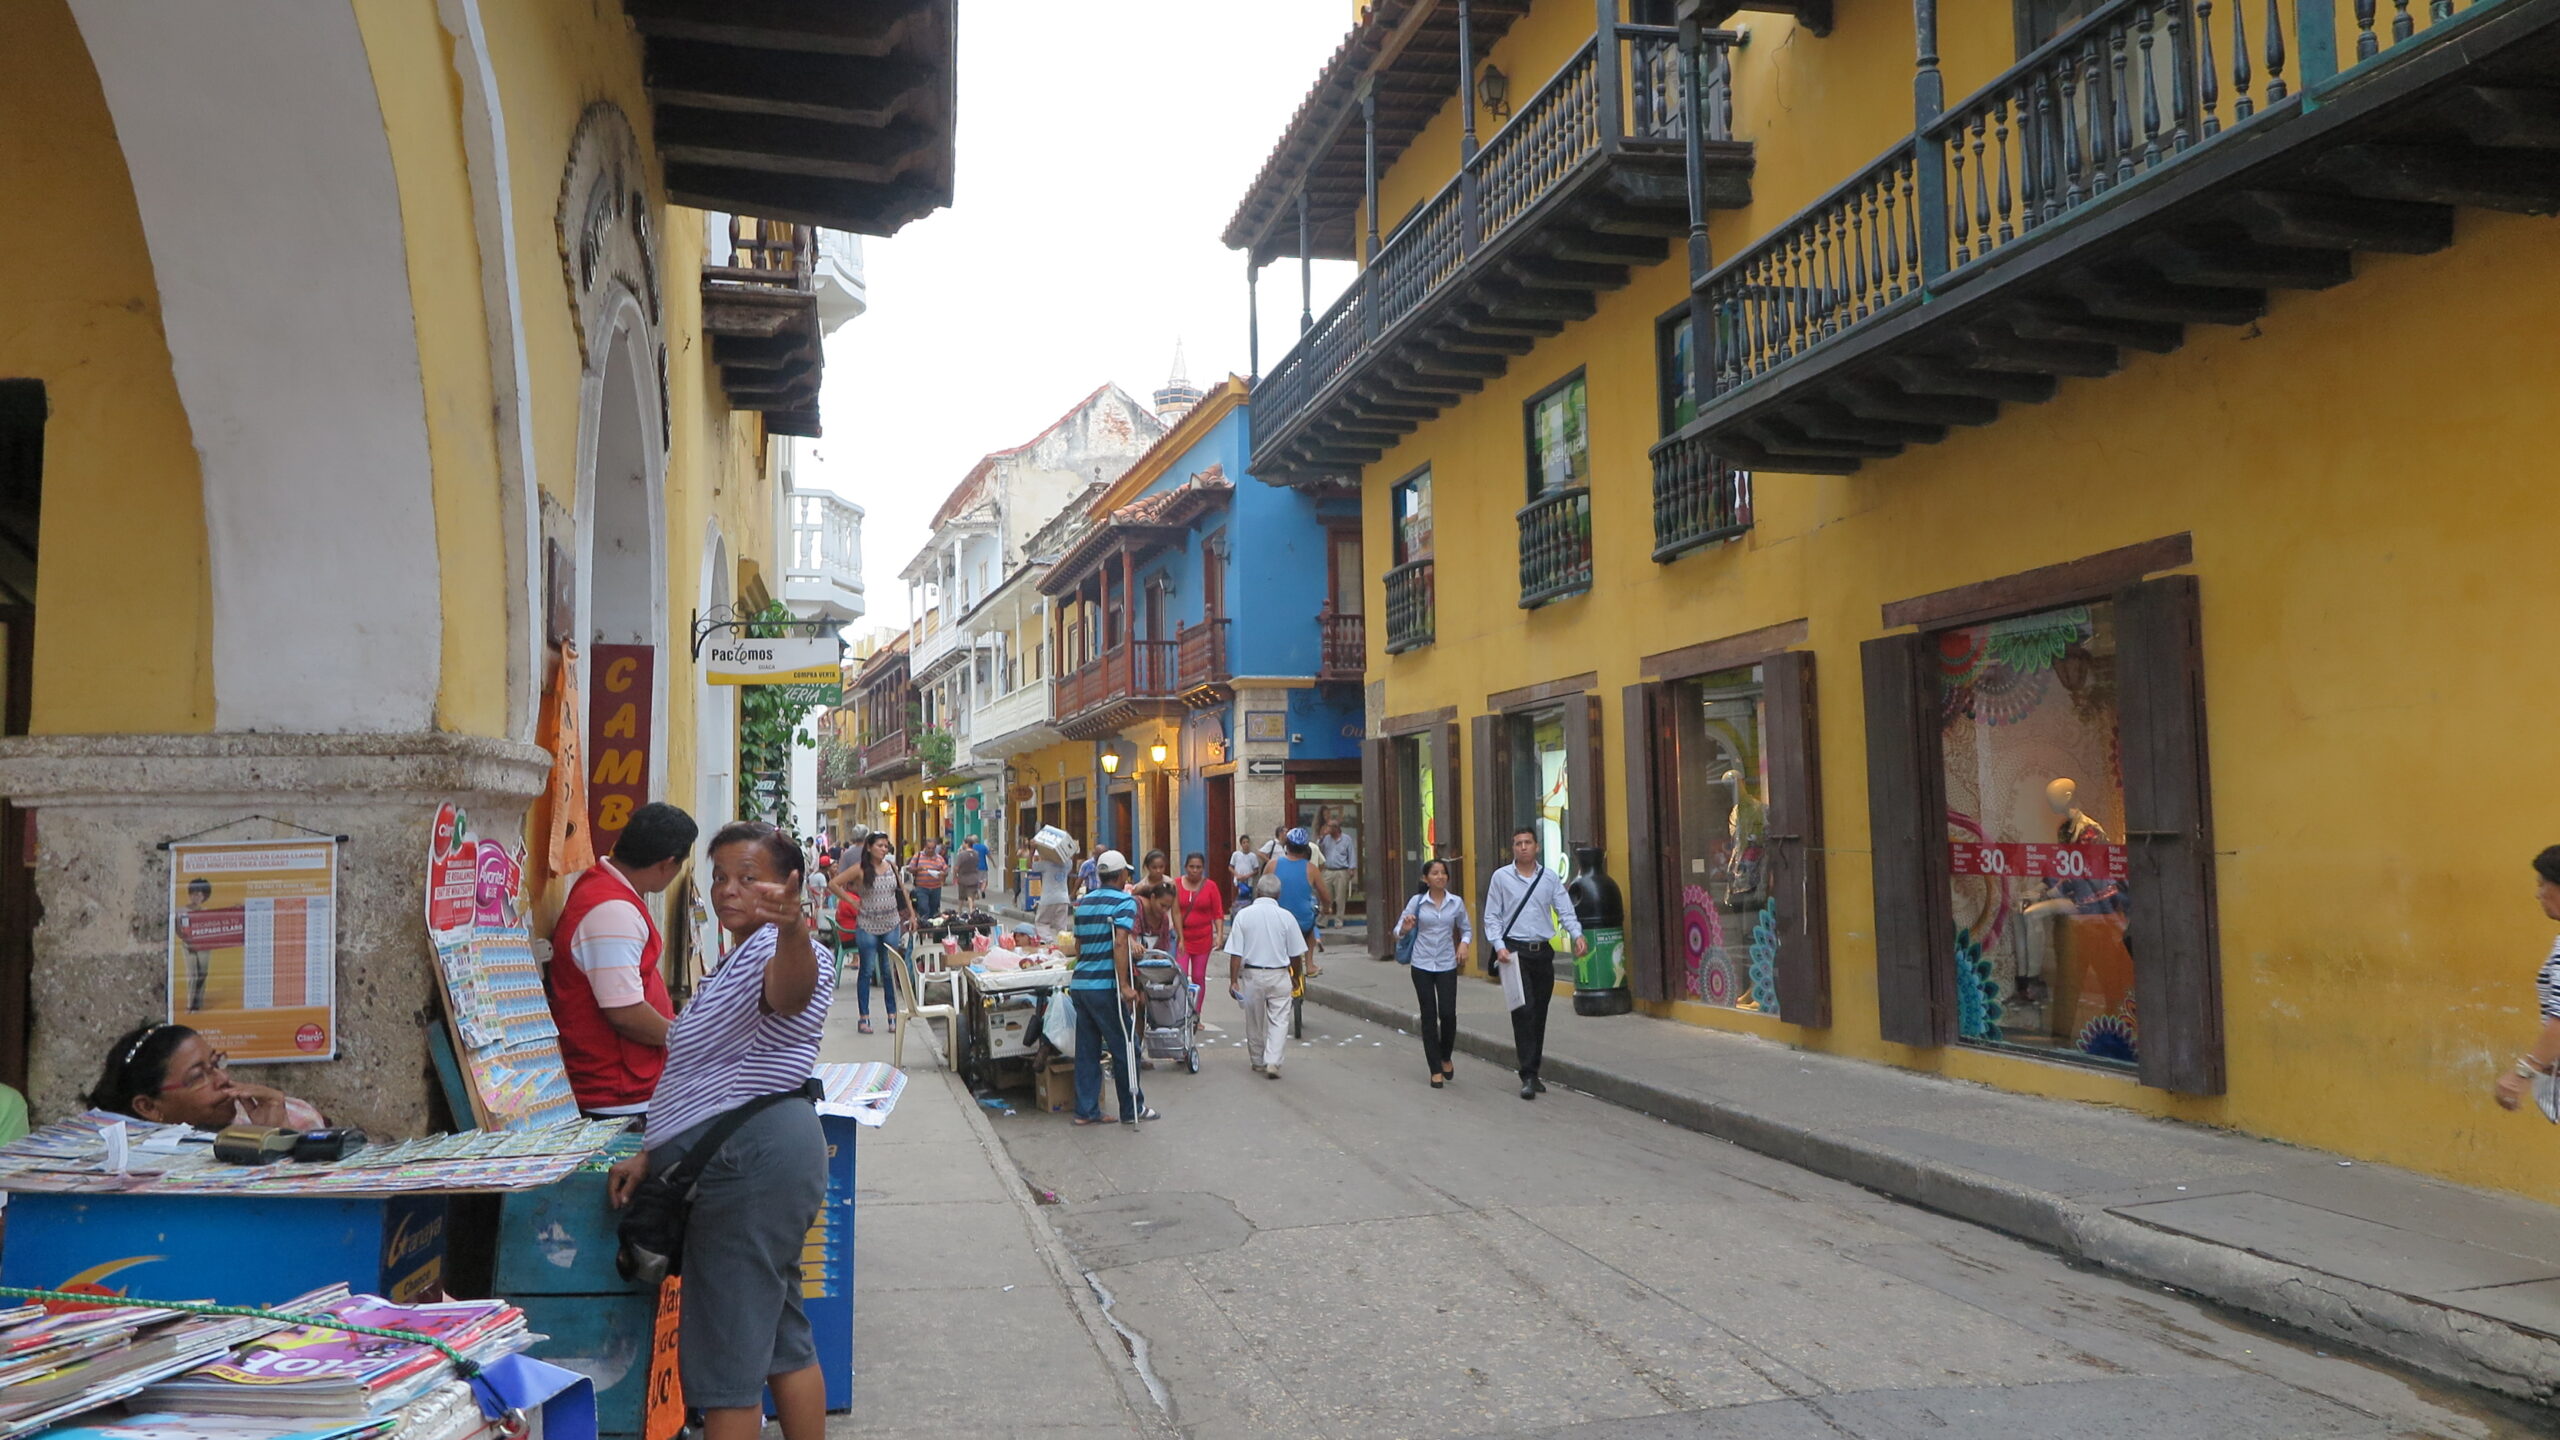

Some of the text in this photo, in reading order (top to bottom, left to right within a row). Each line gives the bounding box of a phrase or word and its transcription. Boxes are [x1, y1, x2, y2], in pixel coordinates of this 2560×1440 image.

[592, 656, 643, 858] CAMB
[271, 852, 290, 860] CADA
[291, 851, 324, 859] LLAMADA
[191, 924, 243, 936] PREPAGO CLARO
[296, 1031, 320, 1042] Claro
